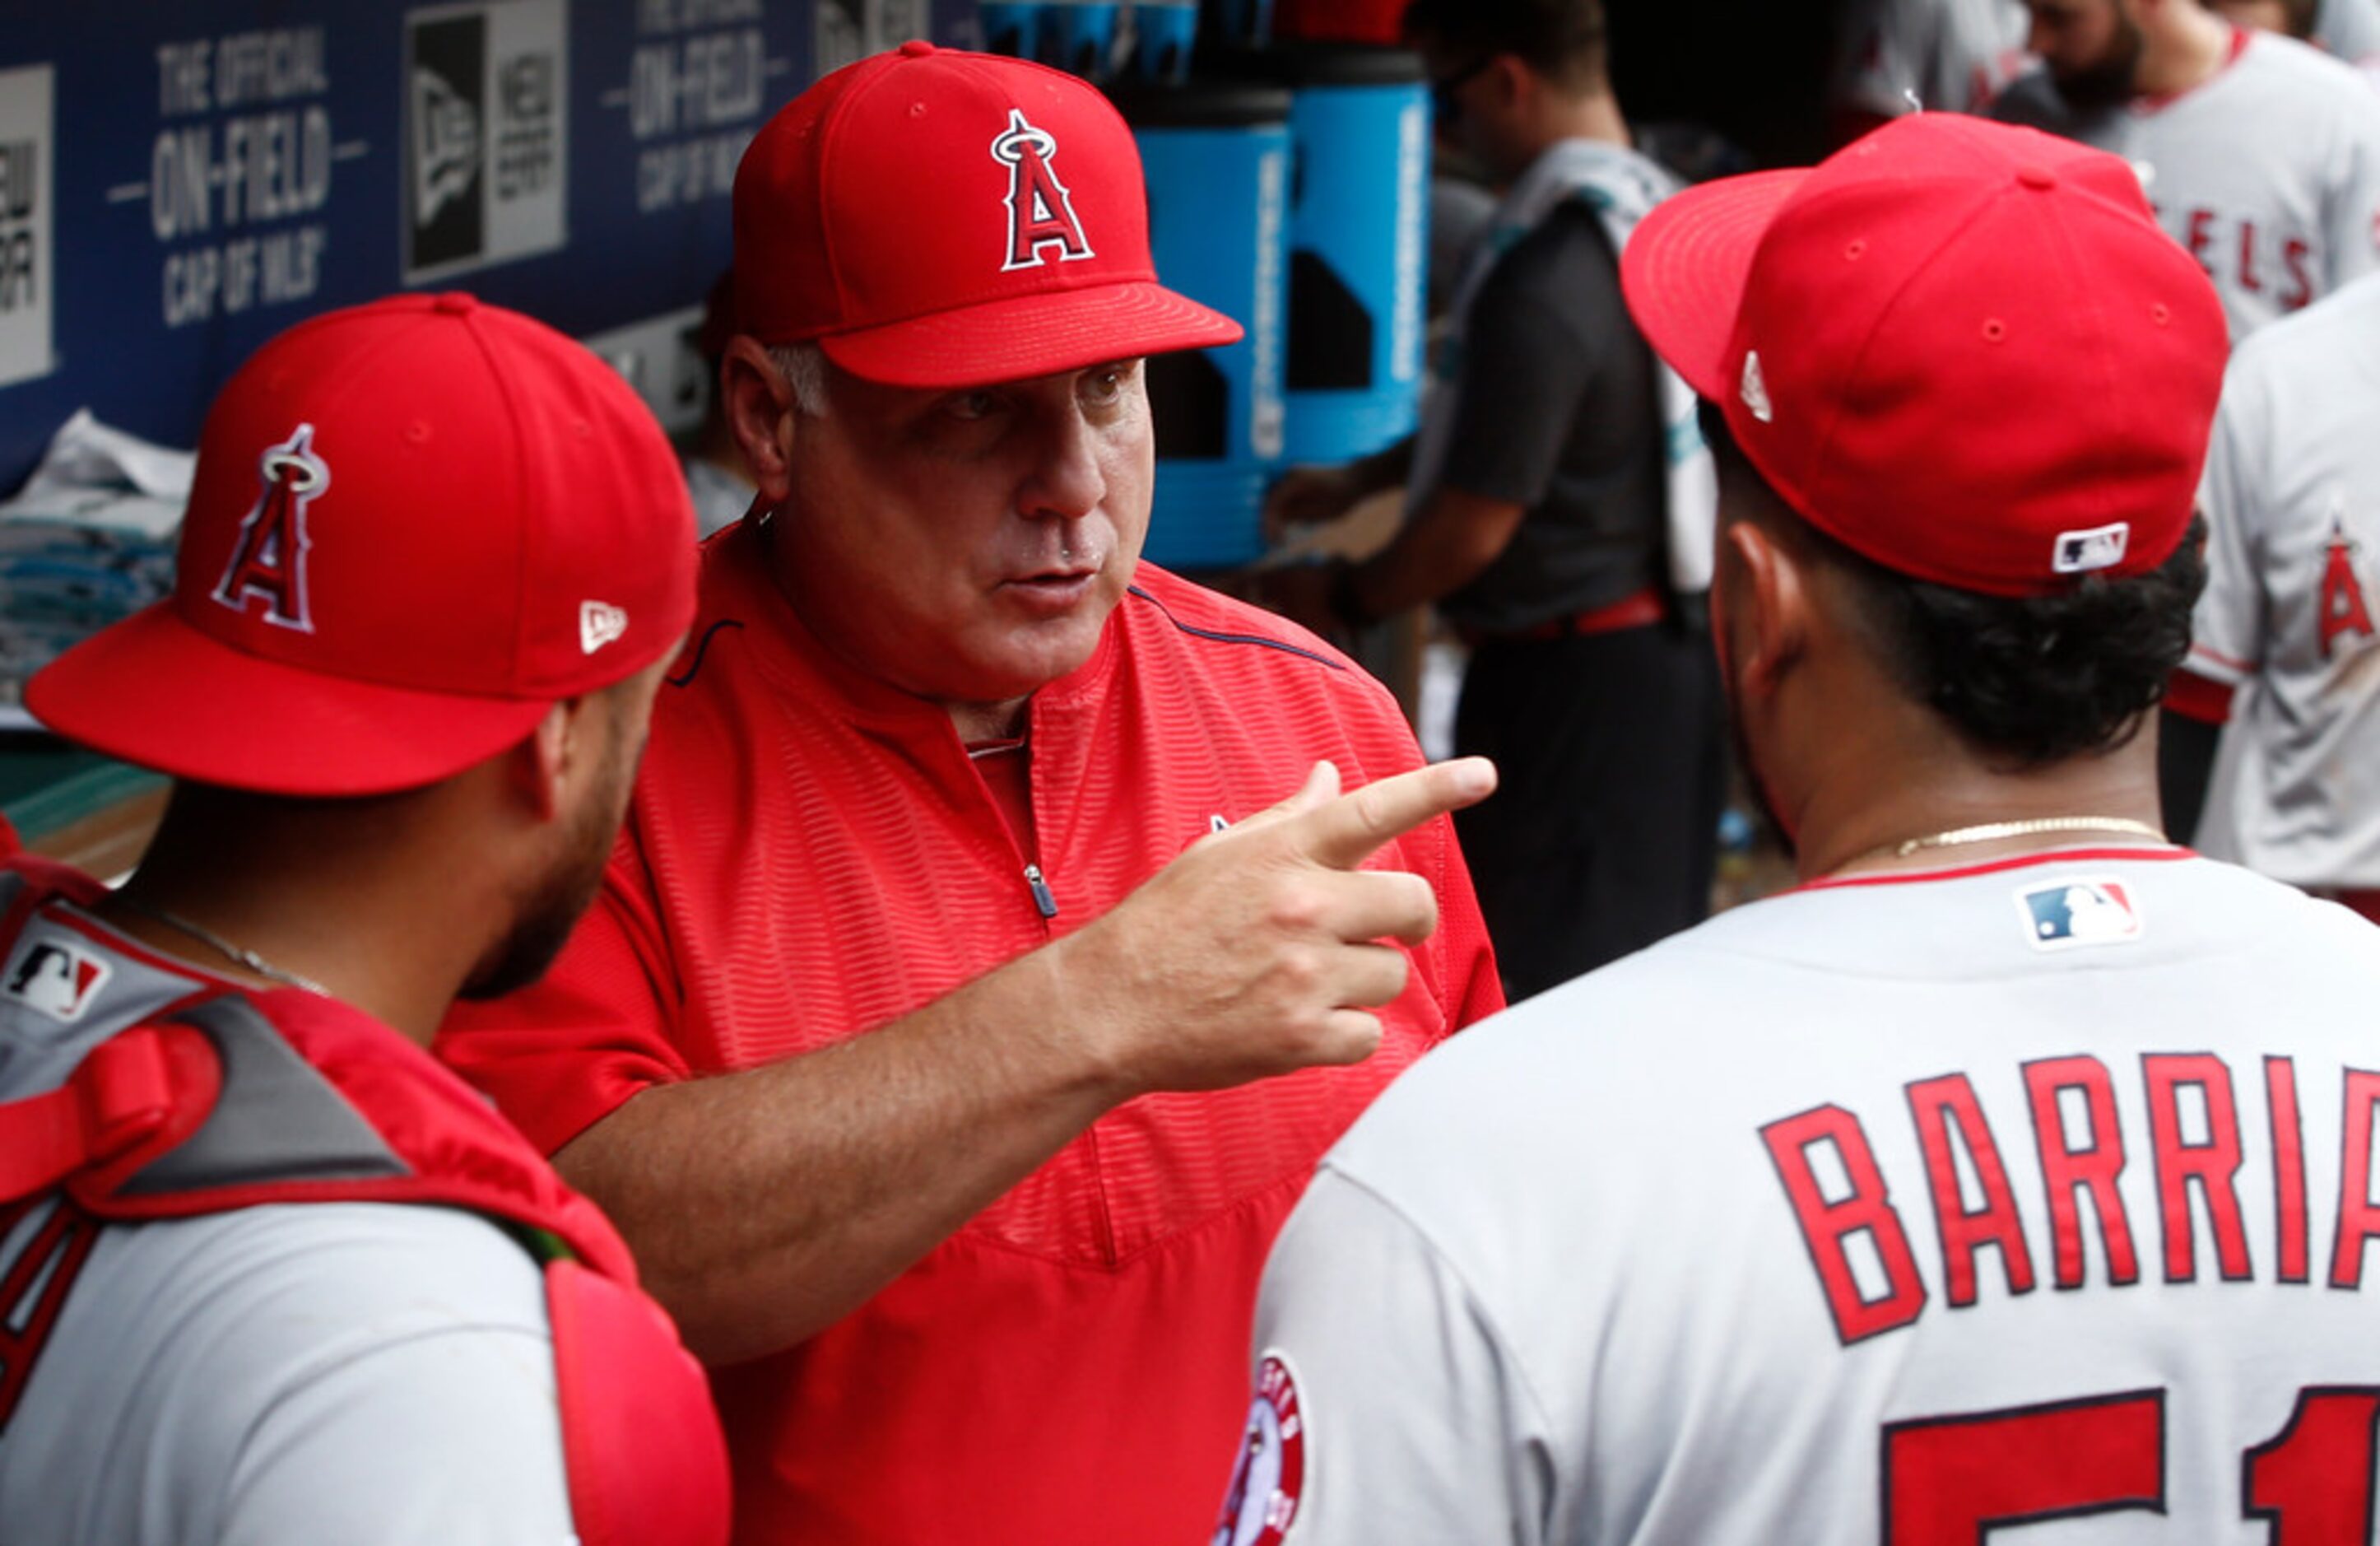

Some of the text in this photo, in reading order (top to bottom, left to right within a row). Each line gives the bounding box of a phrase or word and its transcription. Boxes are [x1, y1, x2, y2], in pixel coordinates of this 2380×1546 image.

[157, 26, 328, 118] THE OFFICIAL
[151, 107, 331, 240] ON-FIELD
[165, 247, 219, 328] CAP
[222, 235, 258, 313] OF
[2153, 204, 2314, 314] ELS
